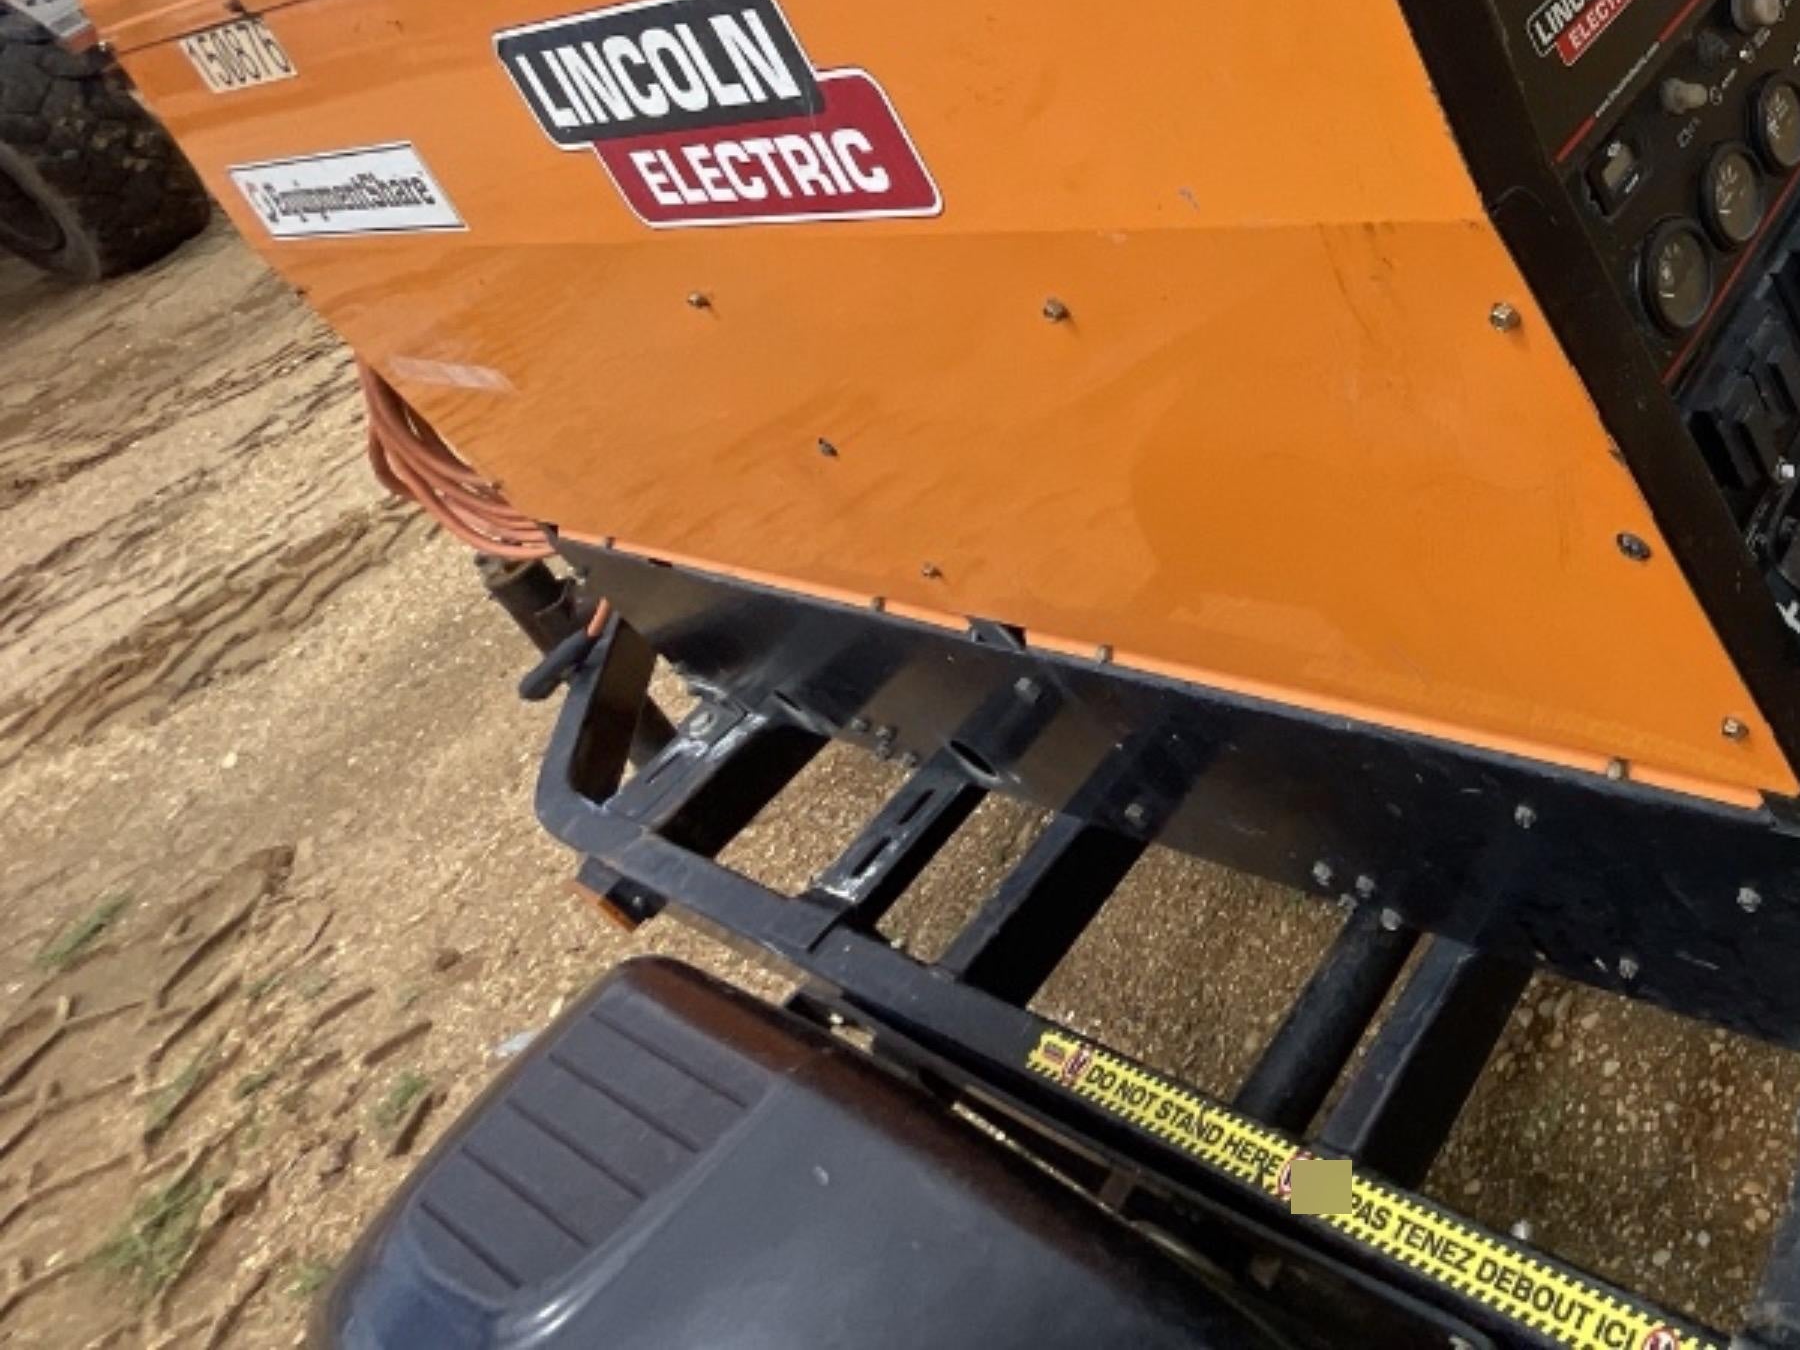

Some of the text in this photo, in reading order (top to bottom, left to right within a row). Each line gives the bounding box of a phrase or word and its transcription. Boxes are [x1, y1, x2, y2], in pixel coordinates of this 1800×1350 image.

[515, 7, 801, 129] LINCOLN
[629, 127, 891, 207] ELECTRIC
[1085, 1064, 1117, 1090] DO
[1115, 1079, 1158, 1112] NOT
[1154, 1099, 1225, 1145] STAND
[1222, 1133, 1285, 1176] HERE
[1394, 1214, 1477, 1274] TENEZ
[1474, 1257, 1595, 1325] DEBOUT
[1593, 1313, 1637, 1350] ICI
